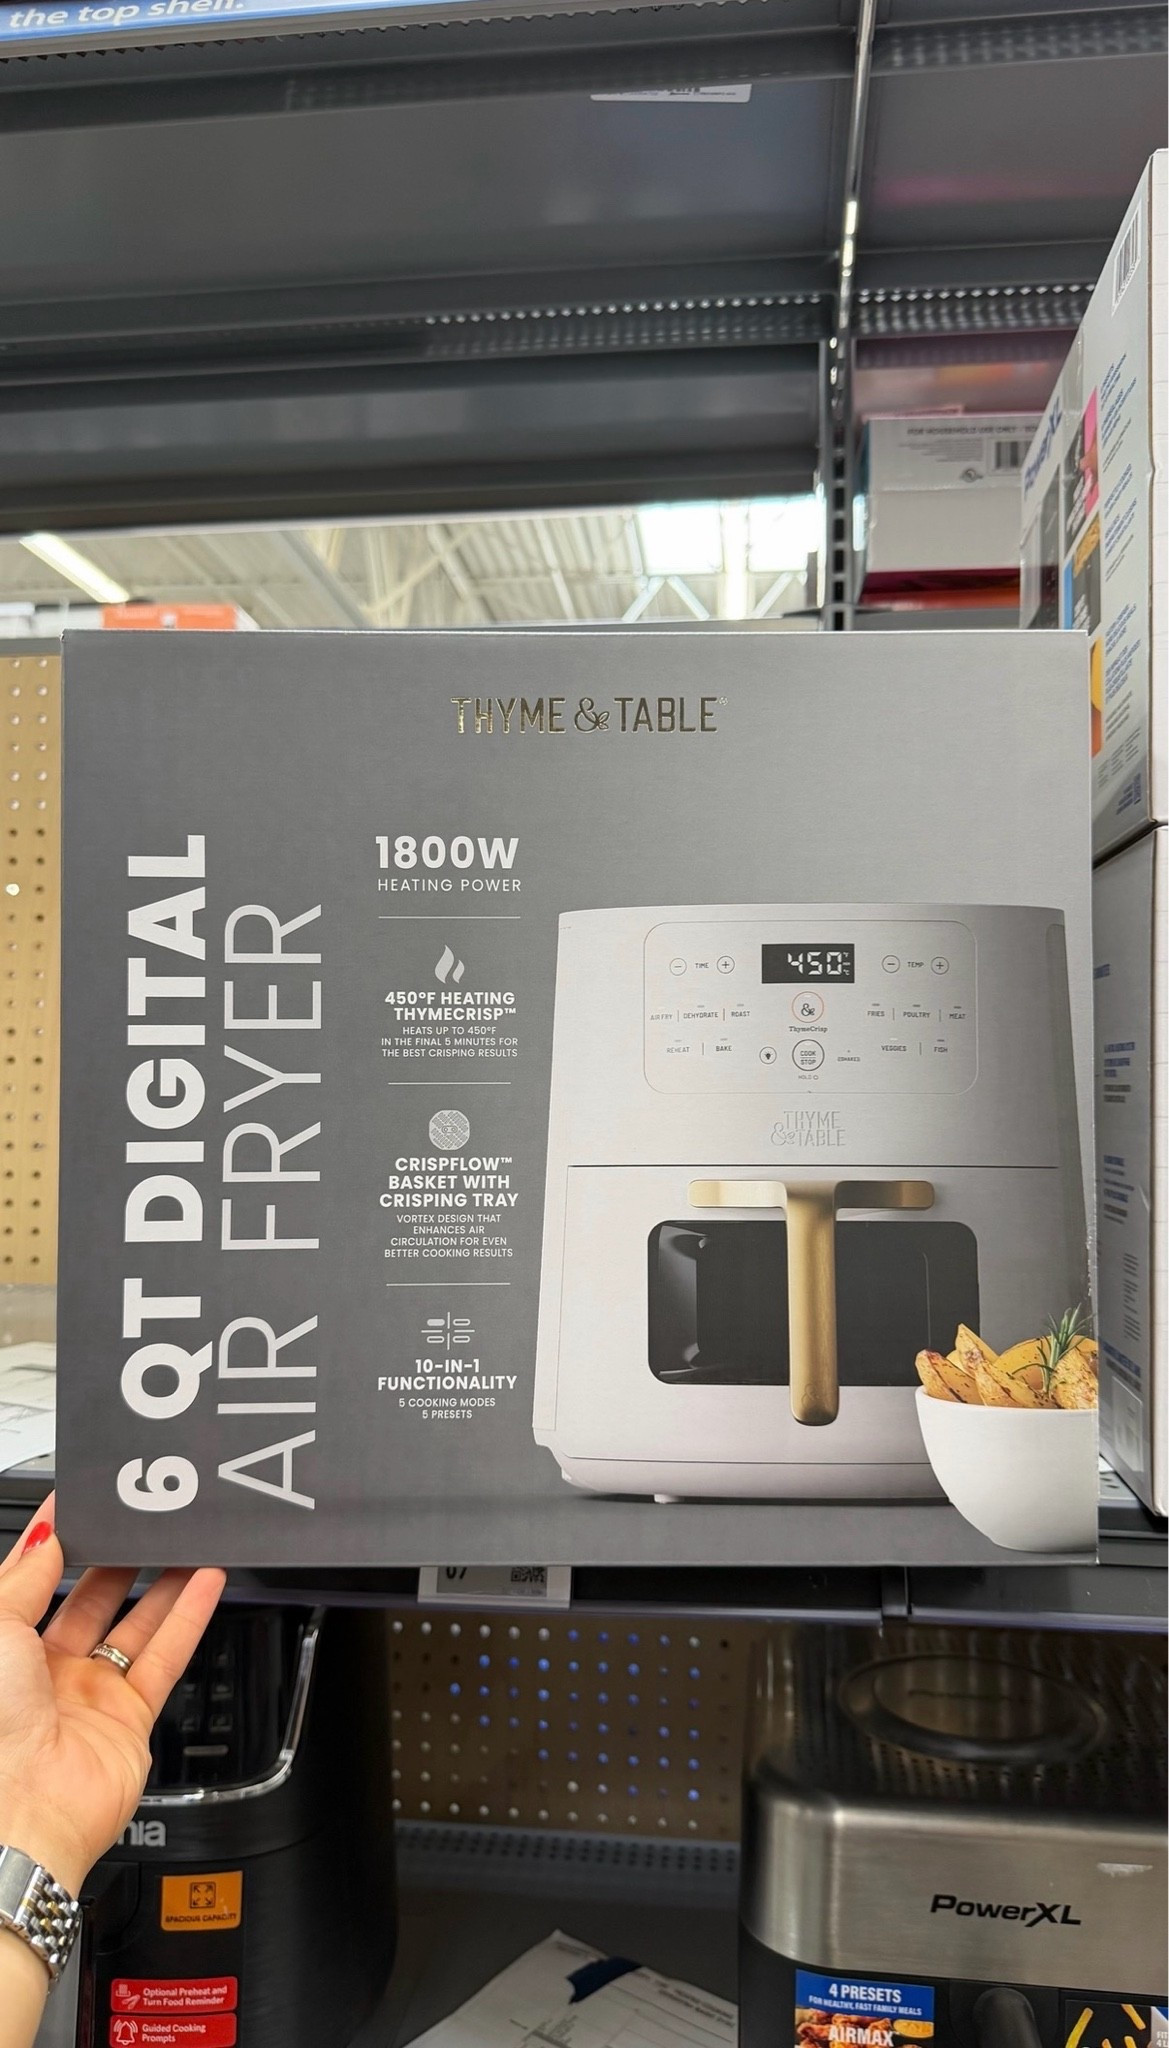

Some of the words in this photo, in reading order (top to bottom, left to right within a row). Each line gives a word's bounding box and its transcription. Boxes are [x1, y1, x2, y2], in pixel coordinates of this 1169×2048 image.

[9, 8, 69, 28] the
[78, 5, 140, 26] top
[451, 697, 566, 734] THYME
[574, 697, 611, 733] &
[375, 835, 520, 870] 1800W
[377, 878, 453, 892] HEATING
[460, 878, 522, 892] POWER
[907, 961, 925, 969] TEMP
[384, 991, 436, 1006] 450°F
[440, 991, 516, 1006] HEATING
[683, 1011, 719, 1019] DEHYDRATE
[867, 1010, 886, 1018] FRIES
[902, 1011, 931, 1019] POULTRY
[402, 1026, 433, 1035] HEATS
[435, 1026, 449, 1035] UP
[451, 1026, 465, 1035] TO
[788, 1025, 829, 1034] ThymeCrisp
[124, 834, 206, 1243] DIGITAL
[381, 1038, 392, 1046] IN
[394, 1038, 412, 1046] THE
[415, 1038, 442, 1046] FINAL
[444, 1038, 452, 1046] 5
[454, 1037, 496, 1046] MINUTES
[499, 1037, 519, 1046] FOR
[382, 1048, 400, 1057] THE
[402, 1048, 426, 1057] BEST
[428, 1048, 475, 1057] CRISPING
[478, 1048, 518, 1057] RESULTS
[666, 1046, 691, 1054] REHEAT
[881, 1045, 907, 1053] VEGGIES
[933, 1046, 949, 1054] FISH
[220, 903, 322, 1251] FRYER
[783, 1110, 841, 1130] THYME
[795, 1129, 847, 1147] TABLE
[388, 1175, 458, 1190] BASKET
[462, 1175, 510, 1189] WITH
[379, 1193, 468, 1207] CRISPING
[472, 1193, 519, 1207] TRAY
[396, 1214, 435, 1223] VORTEX
[437, 1214, 474, 1223] DESIGN
[477, 1214, 502, 1223] THAT
[413, 1226, 466, 1235] ENHANCES
[468, 1226, 485, 1235] AIR
[390, 1237, 457, 1246] CIRCULATION
[460, 1237, 480, 1246] FOR
[482, 1237, 507, 1246] EVEN
[384, 1249, 420, 1258] BETTER
[422, 1249, 471, 1258] COOKING
[473, 1248, 514, 1257] RESULTS
[120, 1277, 213, 1420] QT
[415, 1359, 480, 1373] 10-IN-1
[377, 1375, 518, 1391] FUNCTIONALITY
[399, 1398, 406, 1408] 5
[408, 1398, 458, 1408] COOKING
[460, 1397, 496, 1407] MODES
[216, 1314, 319, 1511] AIR
[422, 1409, 429, 1419] 5
[431, 1409, 473, 1419] PRESETS
[116, 1455, 199, 1512] 6
[930, 1894, 1082, 1928] PowerXL
[165, 1914, 201, 1924] SPACIOUS
[202, 1912, 238, 1923] CAPACITY
[143, 1987, 178, 1998] Optional
[178, 1986, 211, 1996] Preheat
[211, 1984, 228, 1995] and
[828, 1983, 839, 1998] 4
[840, 1983, 902, 2004] PRESETS
[143, 1997, 162, 2007] Turn
[163, 1996, 184, 2007] Food
[184, 1996, 225, 2006] Reminder
[808, 1994, 823, 2005] FOR
[855, 2002, 872, 2012] FAST
[873, 2004, 898, 2014] FAMILY
[898, 2005, 923, 2017] MEALS
[142, 2023, 172, 2033] Guided
[172, 2023, 207, 2034] Cooking
[142, 2033, 176, 2045] Prompts
